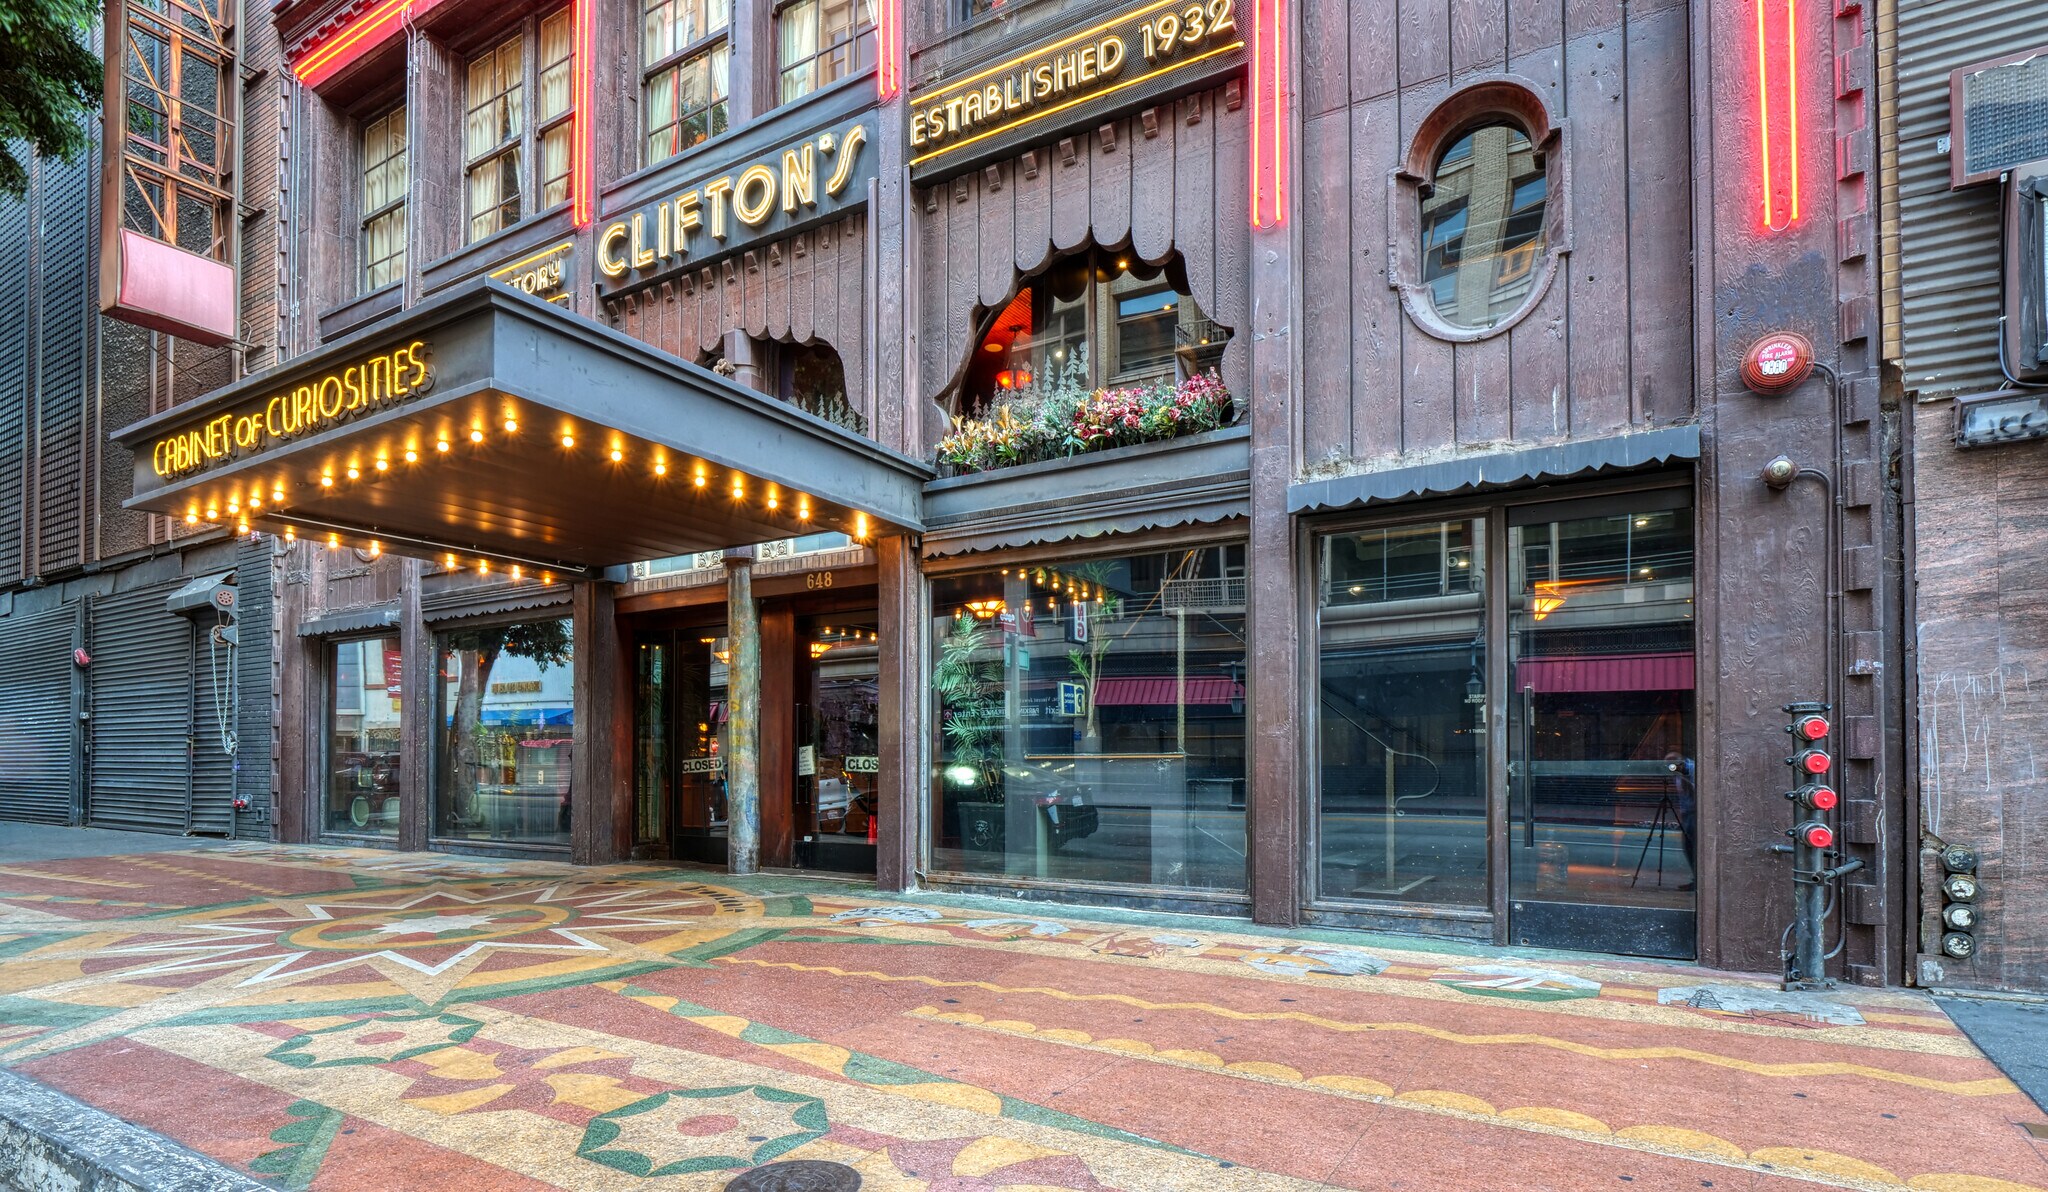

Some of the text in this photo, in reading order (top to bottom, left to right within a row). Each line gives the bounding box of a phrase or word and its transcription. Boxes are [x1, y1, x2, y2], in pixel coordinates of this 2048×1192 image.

[910, 0, 1236, 149] ESTABLISHED 1932
[597, 124, 866, 278] CLIFTON'S
[506, 257, 565, 294] TORY
[1762, 349, 1793, 360] FIRE ALARM
[153, 414, 232, 477] CABINET
[266, 341, 426, 438] CURIOSITIES
[807, 571, 832, 589] 648
[682, 758, 722, 772] CLOSED
[847, 757, 879, 771] CLOS
